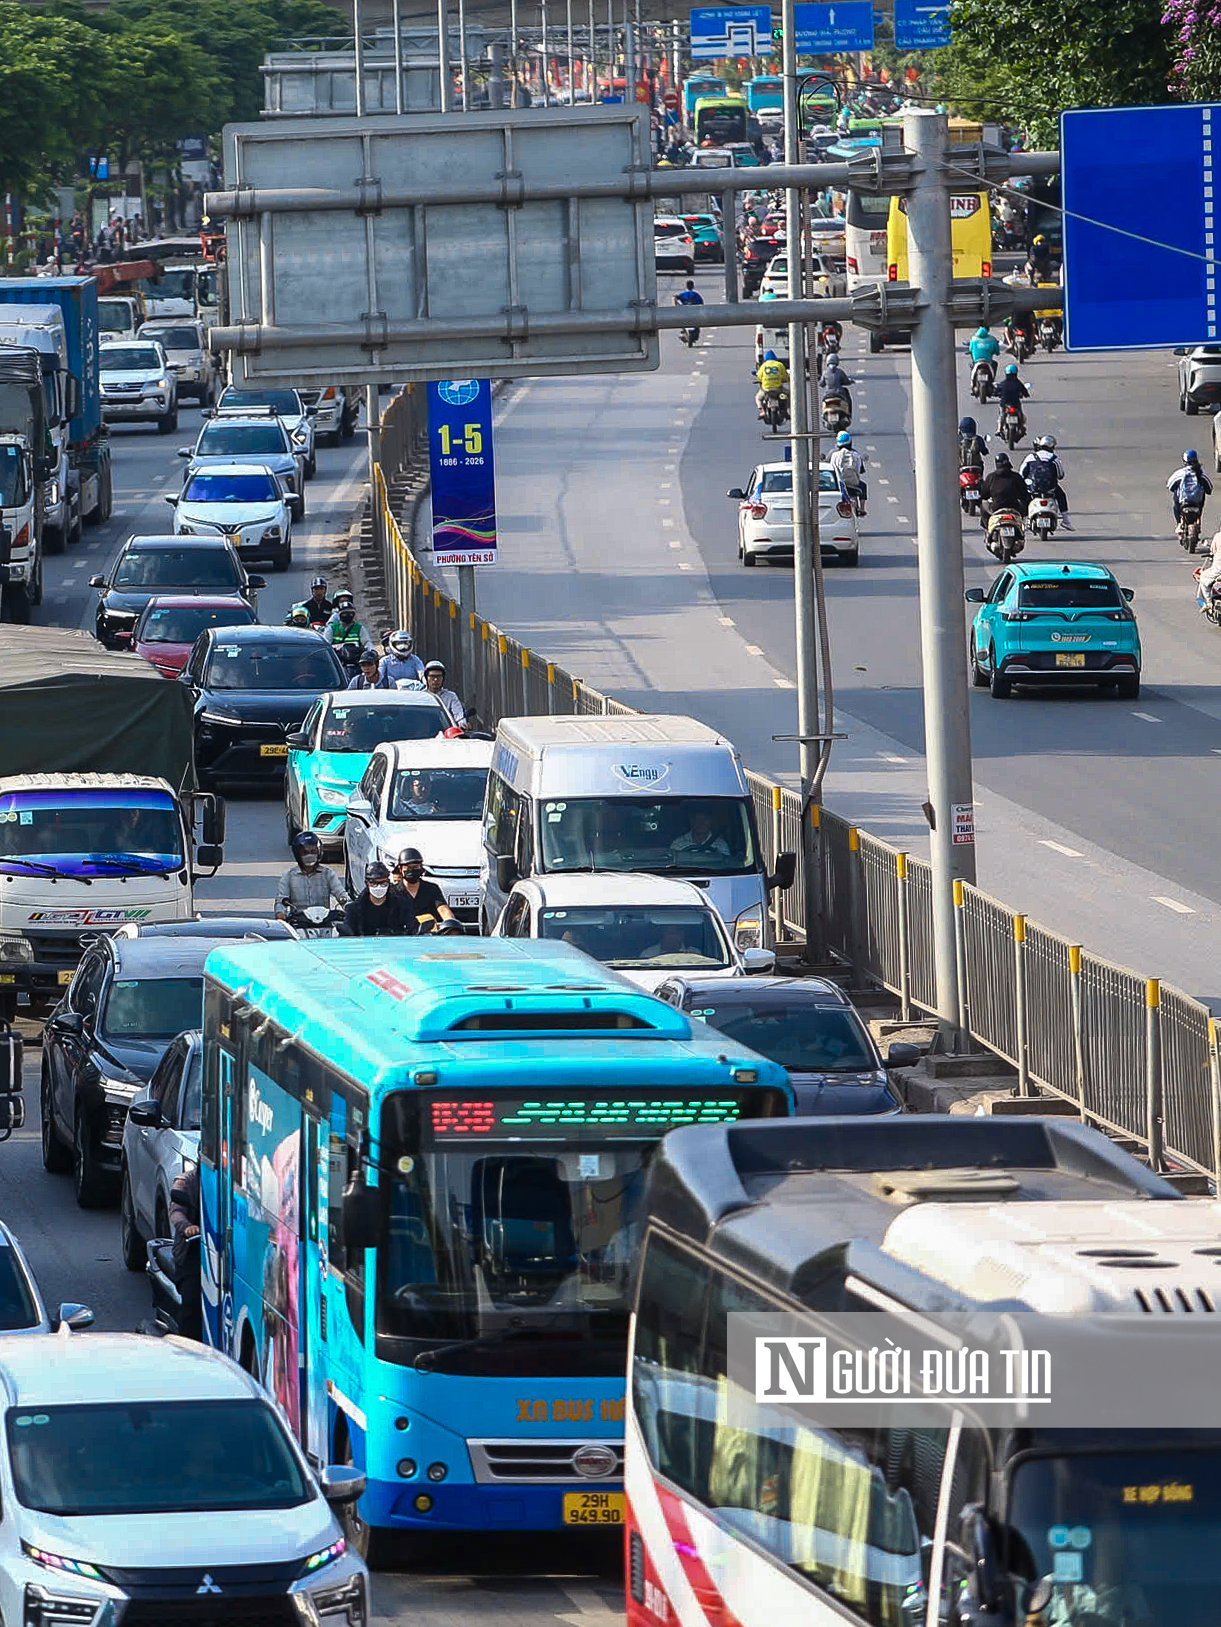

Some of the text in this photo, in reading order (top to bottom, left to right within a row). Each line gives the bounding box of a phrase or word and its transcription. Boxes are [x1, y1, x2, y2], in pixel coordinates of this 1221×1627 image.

[437, 423, 482, 455] 1-5
[465, 456, 484, 465] 2026
[436, 553, 466, 564] PHƯỜNG
[466, 552, 482, 562] YÊN
[620, 764, 658, 780] VEngy
[552, 1398, 593, 1421] BUS
[581, 1494, 609, 1508] 29H
[570, 1509, 621, 1523] 949.90
